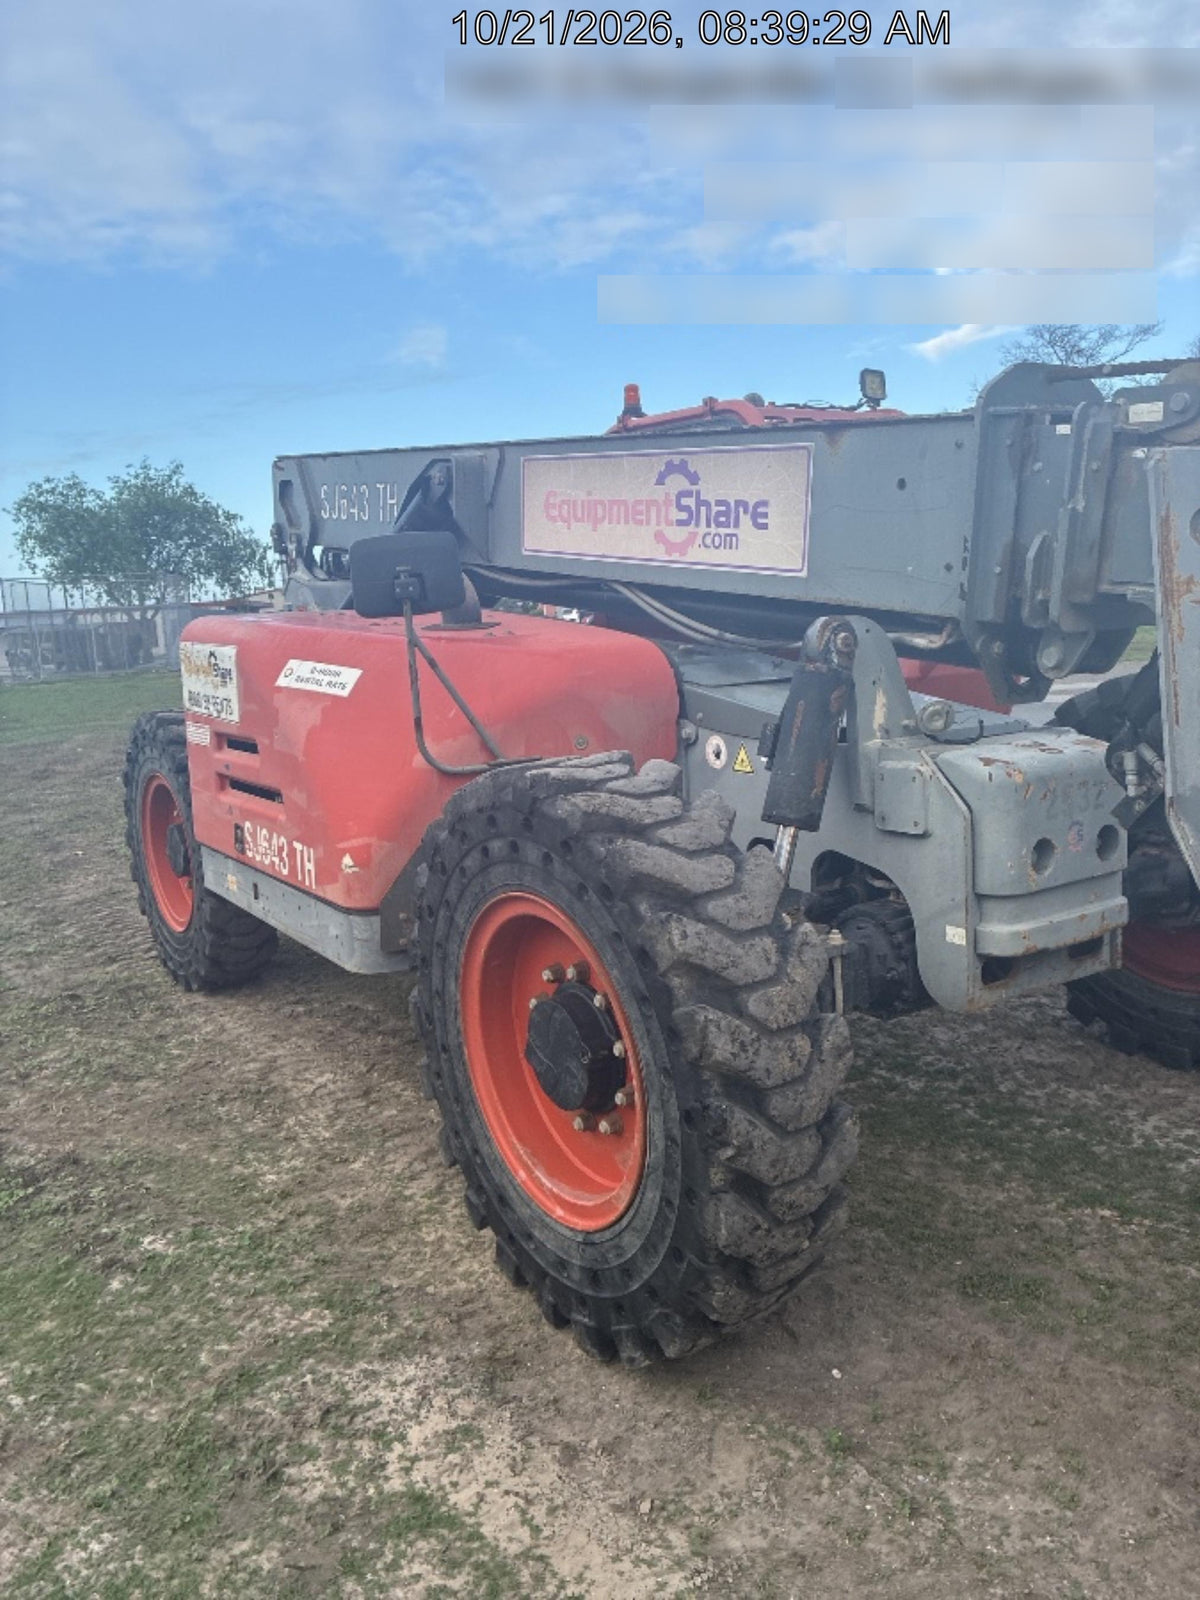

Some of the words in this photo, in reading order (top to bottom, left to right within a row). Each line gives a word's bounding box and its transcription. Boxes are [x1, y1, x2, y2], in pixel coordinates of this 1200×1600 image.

[320, 484, 369, 520] SJ643
[376, 483, 397, 521] TH
[543, 489, 768, 531] EquipmentShare
[698, 531, 739, 550] .com
[244, 821, 289, 876] SJ643
[292, 841, 316, 889] TH
